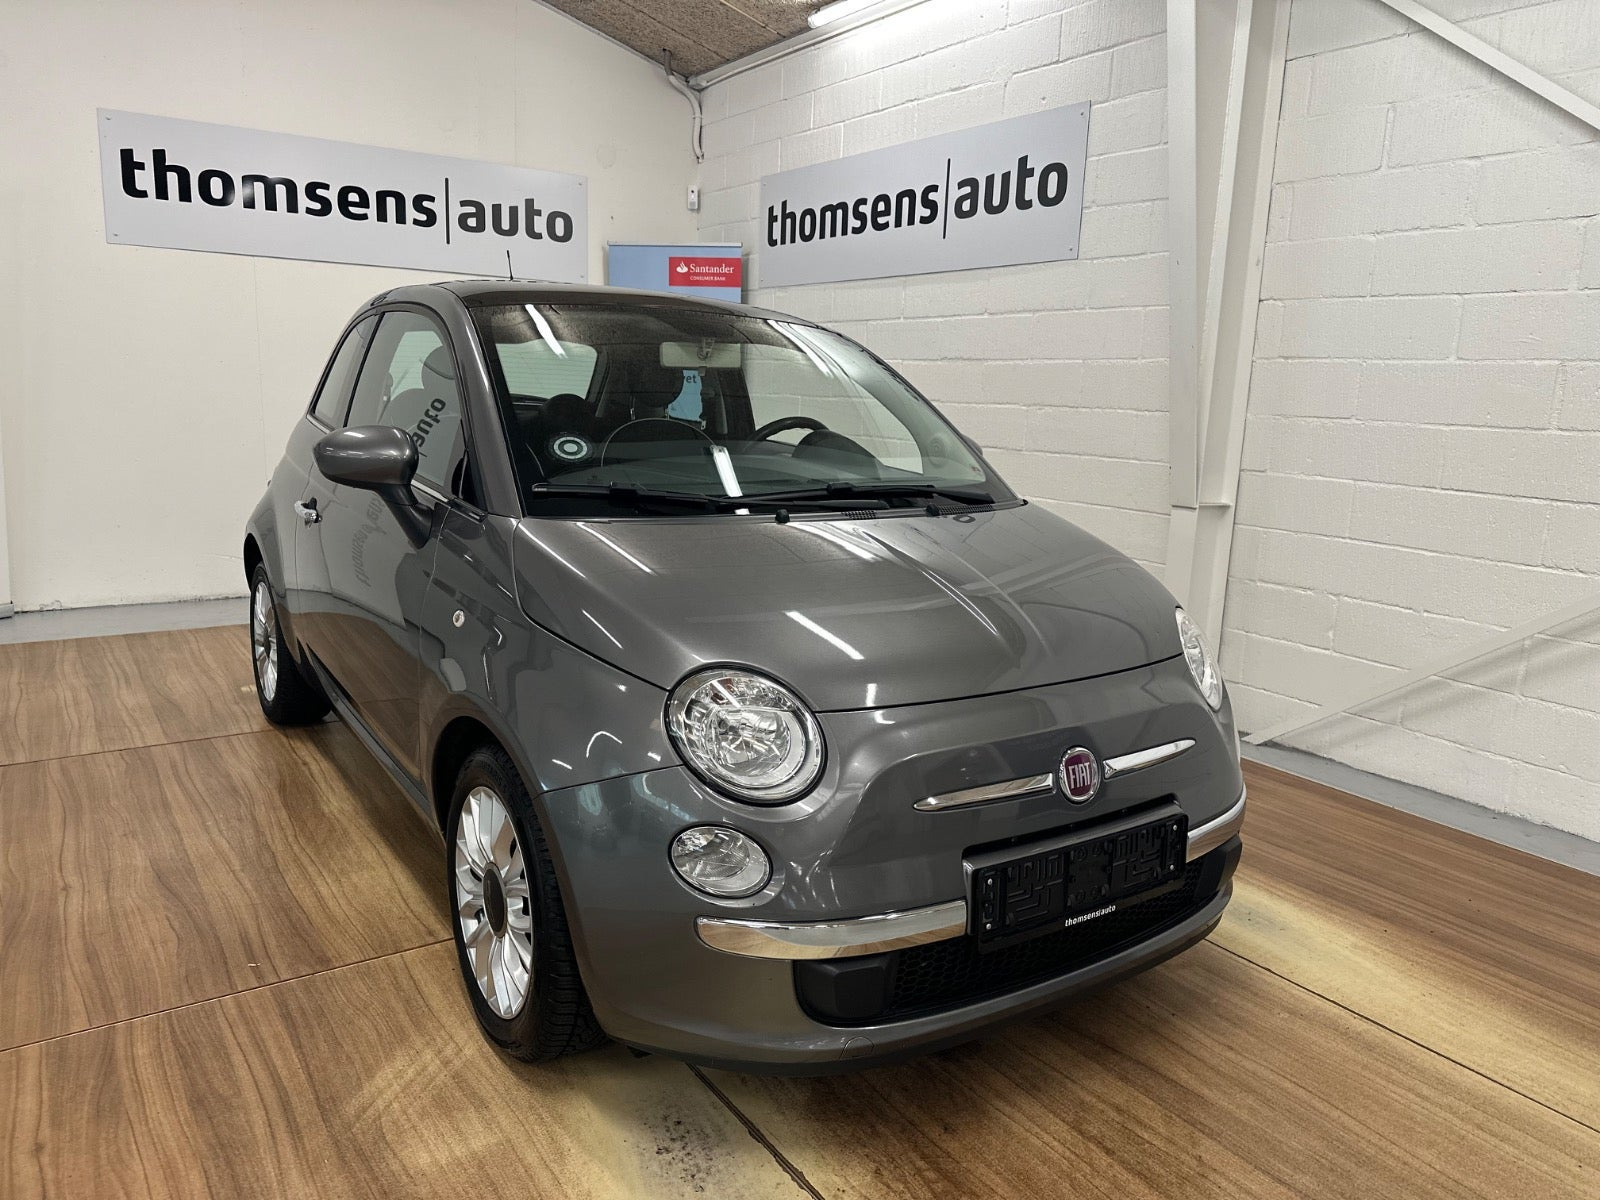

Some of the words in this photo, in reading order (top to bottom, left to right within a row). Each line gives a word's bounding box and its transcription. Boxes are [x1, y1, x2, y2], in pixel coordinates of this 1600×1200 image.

[690, 263, 734, 274] Santander
[684, 374, 698, 384] et
[1068, 762, 1090, 789] FIAT
